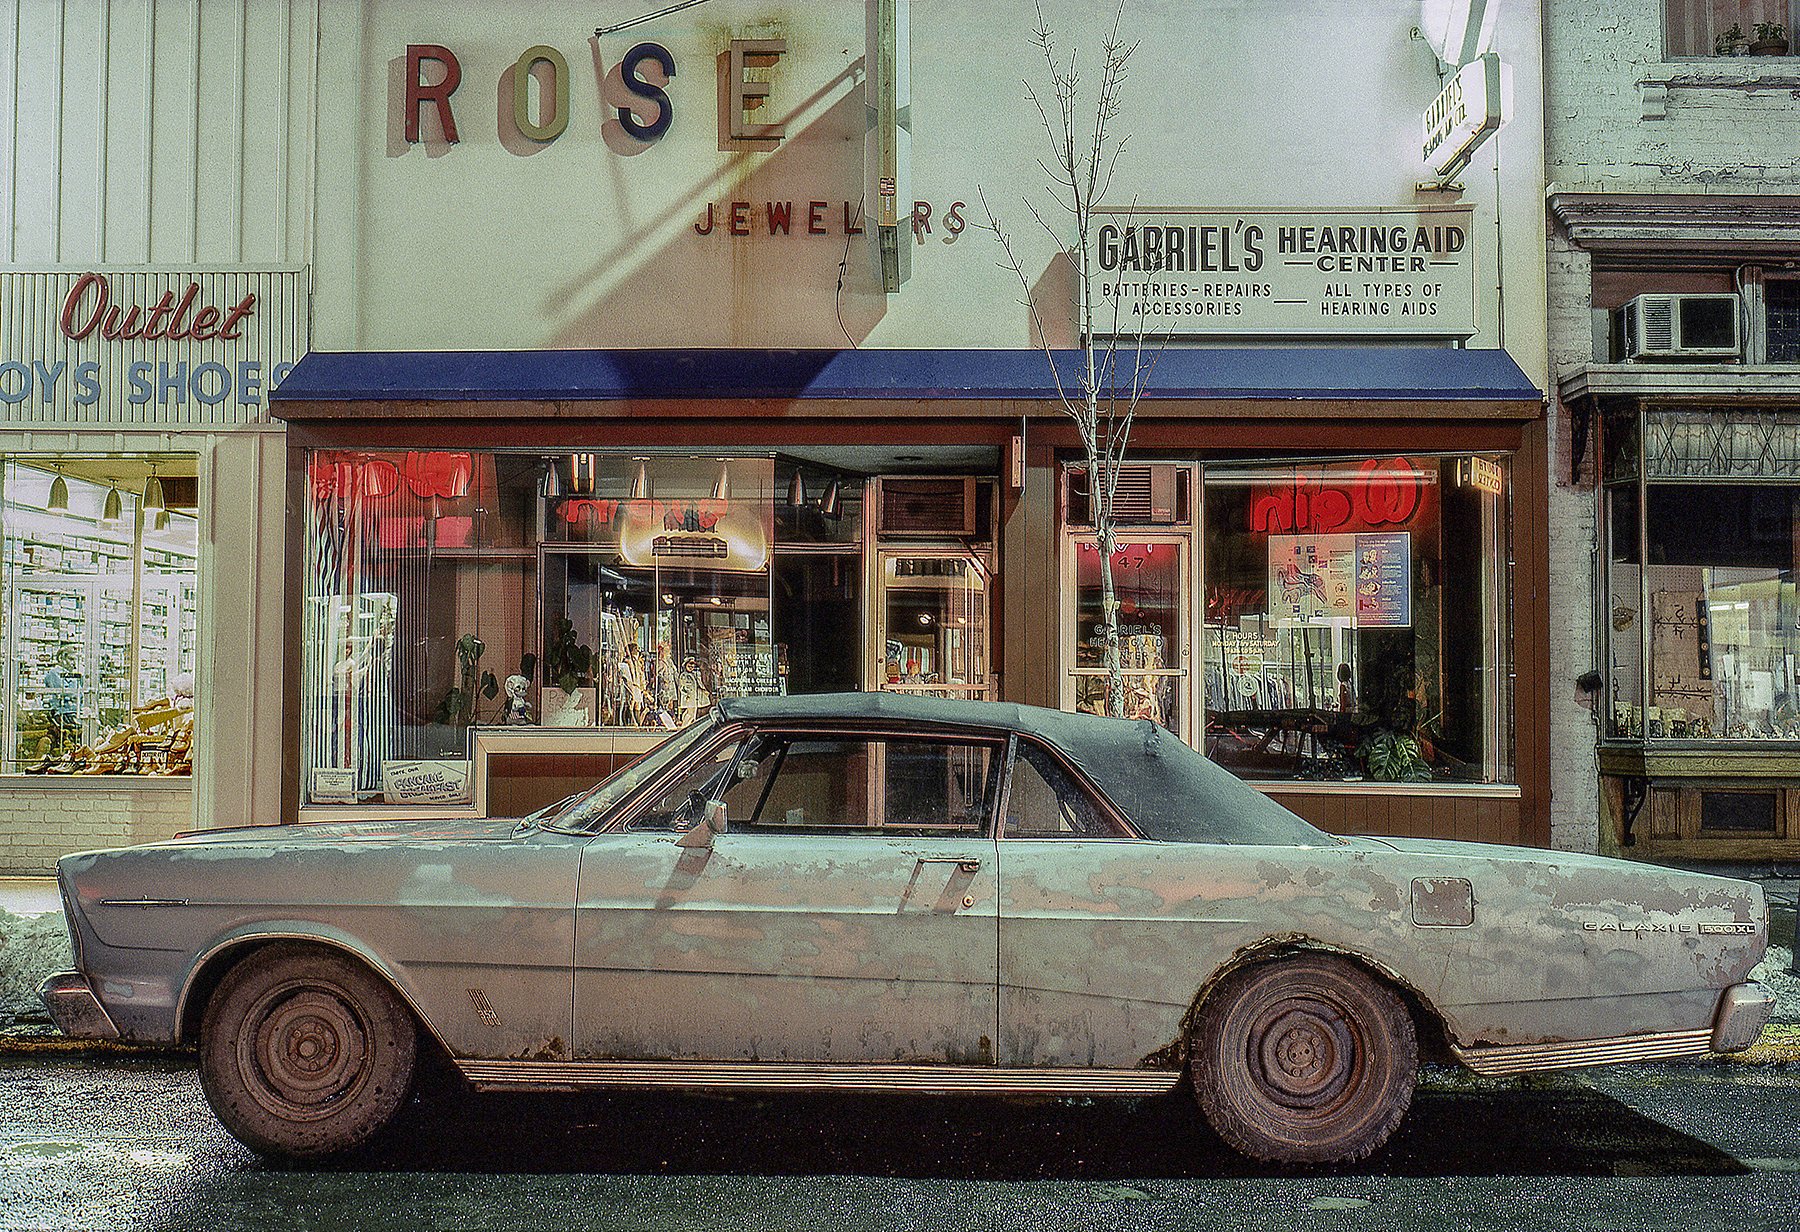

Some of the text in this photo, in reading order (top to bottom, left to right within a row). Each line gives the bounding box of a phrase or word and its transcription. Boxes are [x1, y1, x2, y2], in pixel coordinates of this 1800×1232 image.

[405, 39, 786, 143] ROSE
[694, 201, 966, 235] JEWELRS
[1099, 219, 1264, 271] GABRIEL'S
[1279, 226, 1465, 253] HEARING AID
[1316, 256, 1426, 272] CENTER
[1325, 284, 1442, 297] ALL TYPES OF
[60, 272, 256, 340] Outlet
[1132, 302, 1242, 315] ACCESSORIES
[1321, 302, 1437, 315] HEARING AIDS
[1118, 557, 1144, 568] 47
[1094, 623, 1162, 635] GRIEL'S
[1232, 632, 1258, 640] HOURS
[393, 771, 445, 790] PANCAKE
[1583, 922, 1692, 932] GALAXIE
